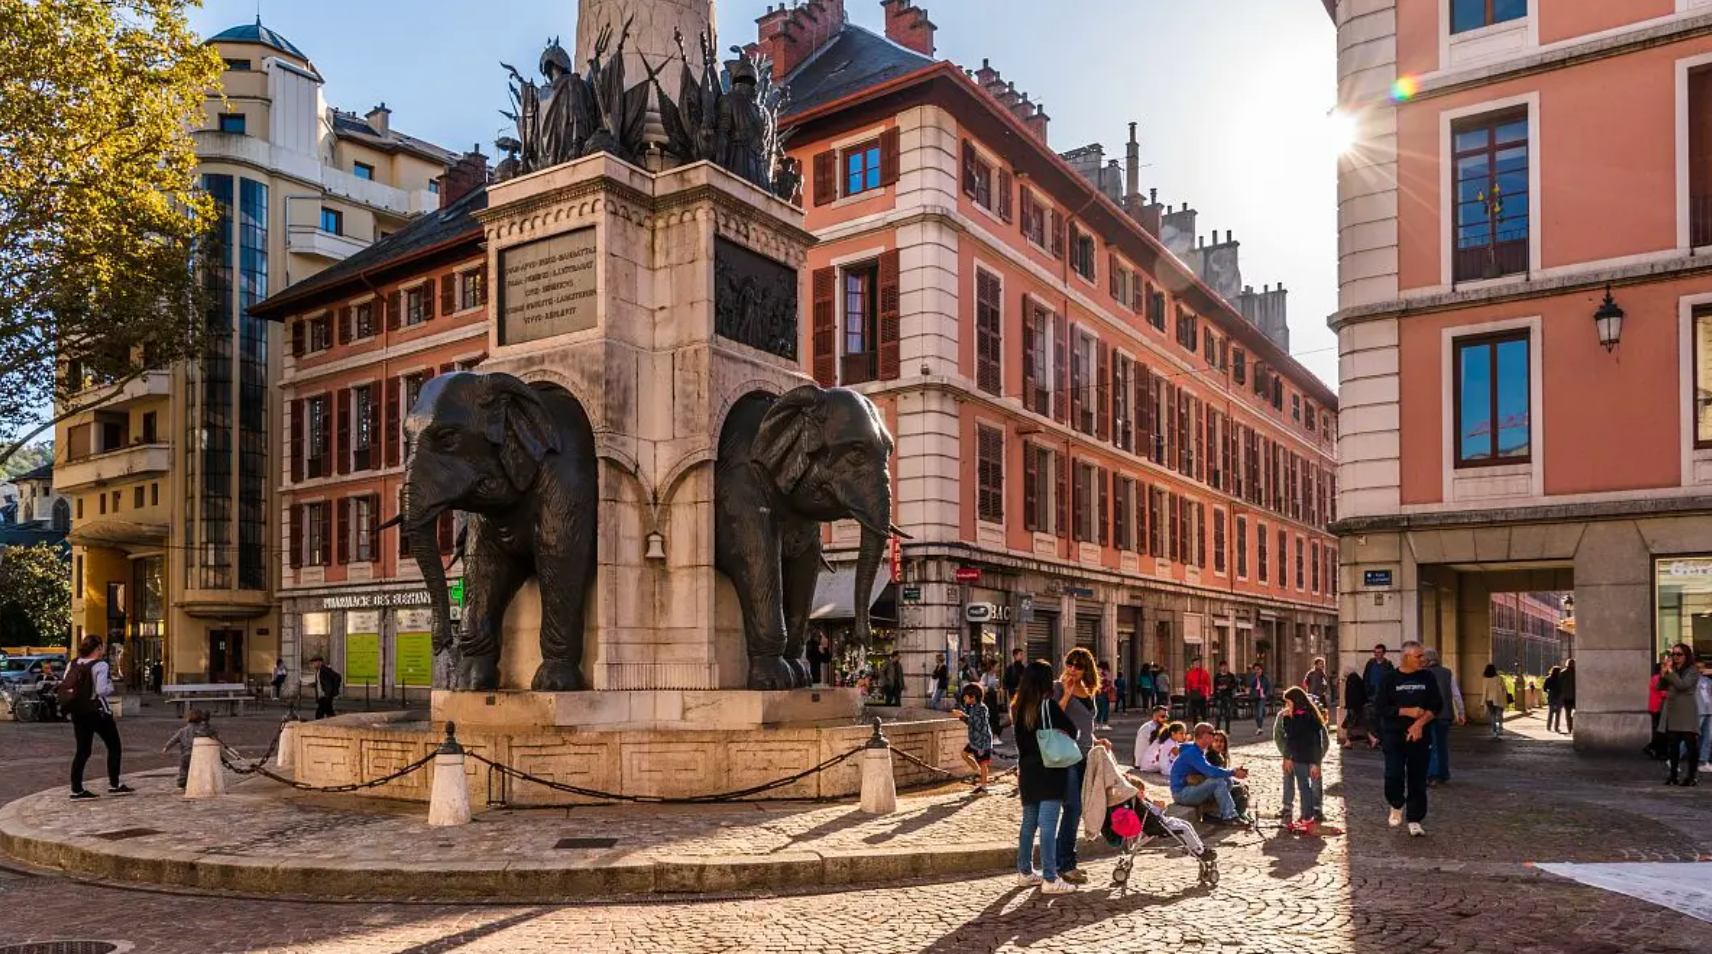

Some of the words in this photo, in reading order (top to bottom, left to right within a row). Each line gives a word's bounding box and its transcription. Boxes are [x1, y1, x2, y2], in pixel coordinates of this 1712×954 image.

[323, 595, 371, 609] PHARMACIE
[374, 594, 390, 606] DES
[991, 604, 1011, 621] BAC
